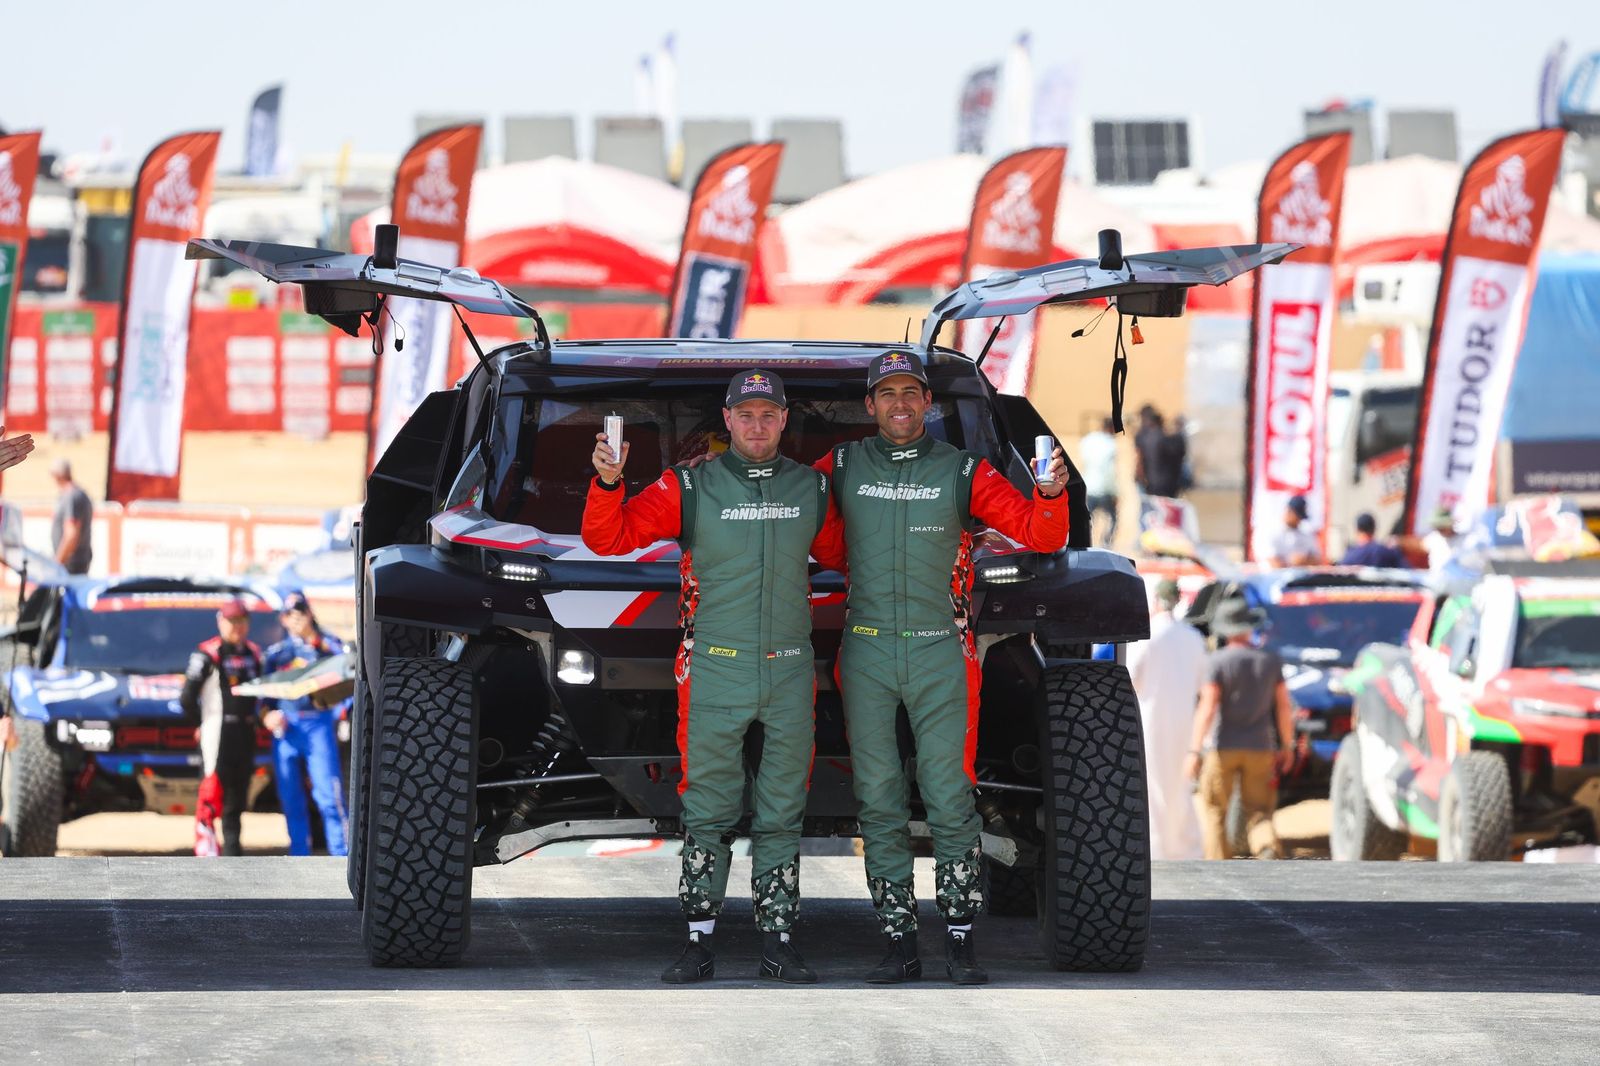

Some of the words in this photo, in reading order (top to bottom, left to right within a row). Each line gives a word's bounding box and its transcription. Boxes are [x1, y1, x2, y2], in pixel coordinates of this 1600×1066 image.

[879, 363, 896, 373] Red
[897, 362, 911, 371] Bull
[741, 384, 757, 394] Red
[758, 384, 772, 394] Bull
[1268, 305, 1316, 489] MOTUL
[1446, 322, 1497, 481] TUDOR
[857, 484, 942, 500] SANDRIDERS
[721, 507, 800, 520] SANDRIDERS
[784, 648, 801, 656] ZENZ
